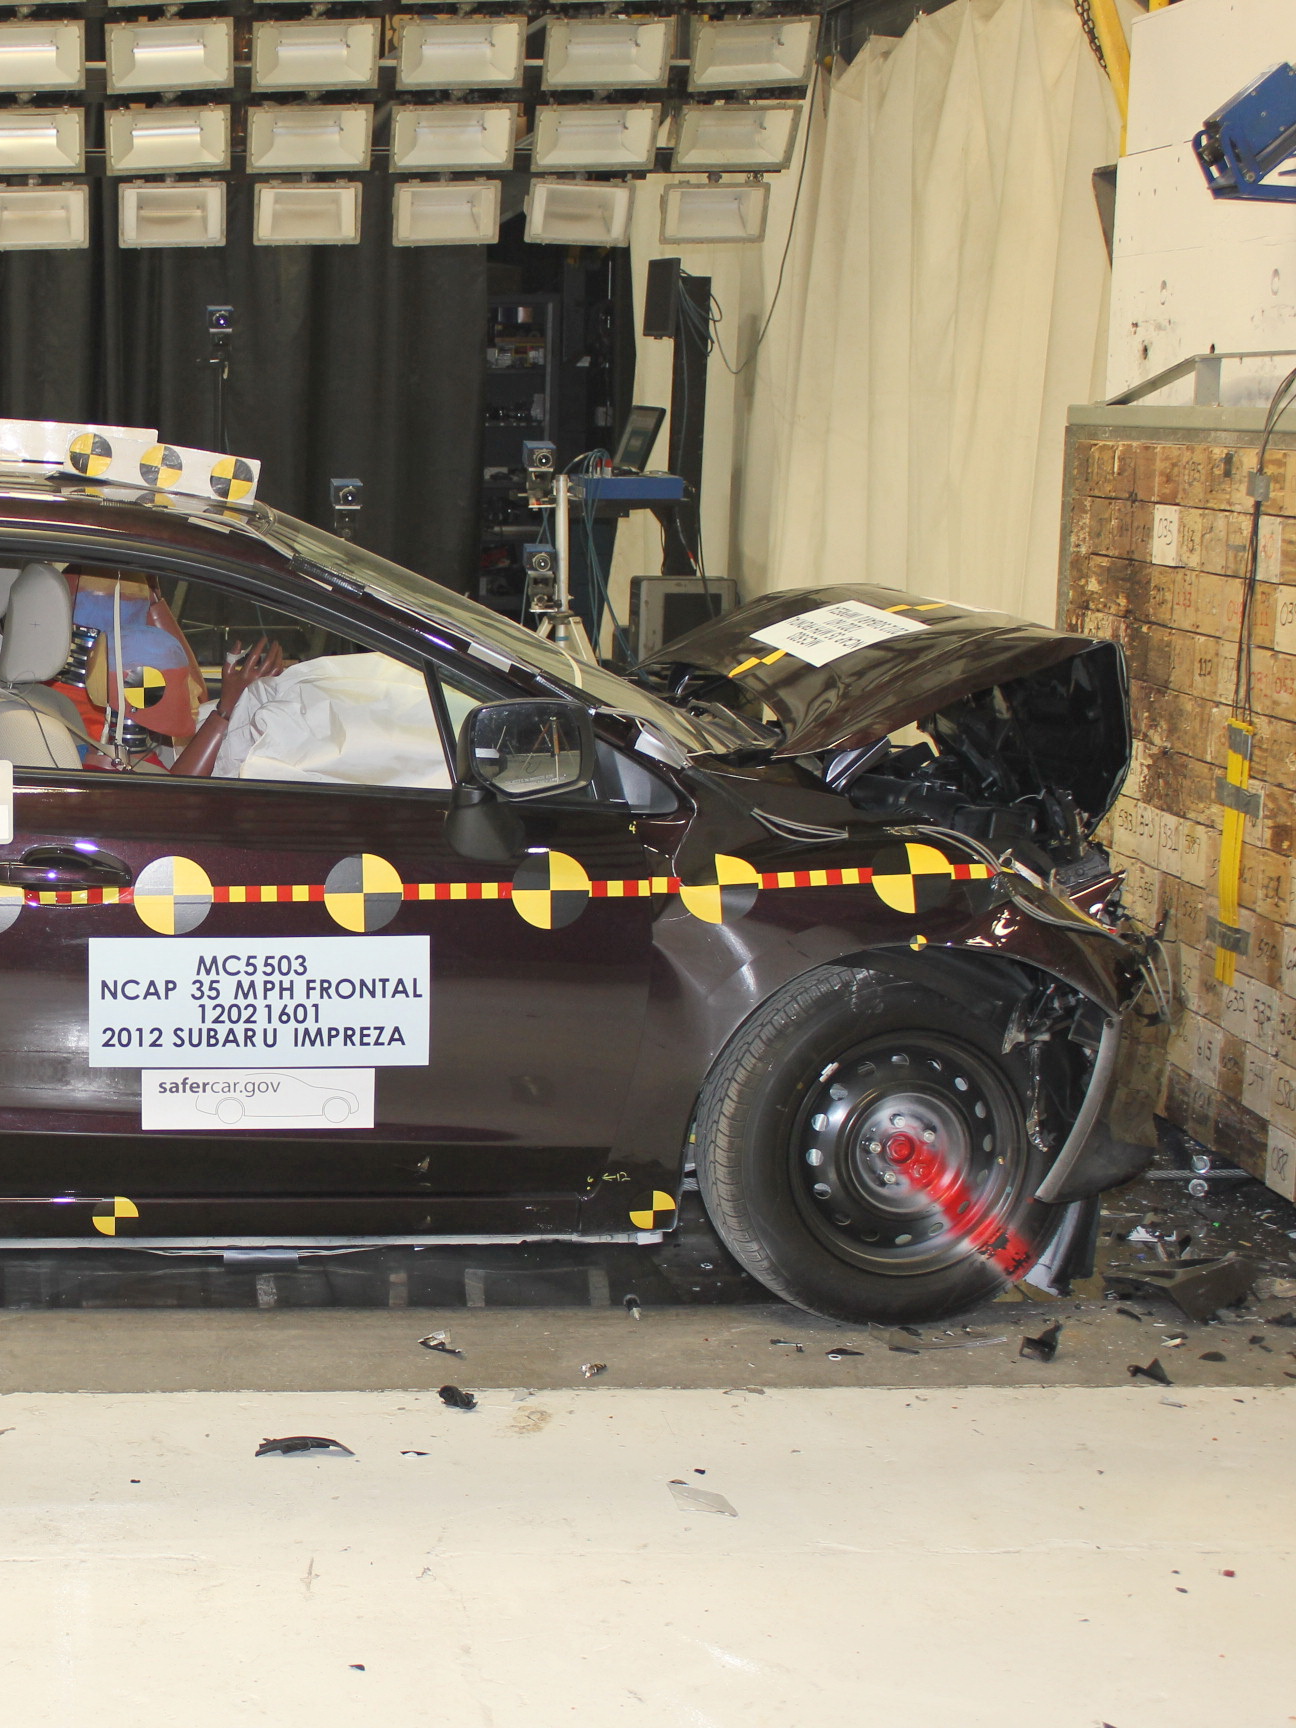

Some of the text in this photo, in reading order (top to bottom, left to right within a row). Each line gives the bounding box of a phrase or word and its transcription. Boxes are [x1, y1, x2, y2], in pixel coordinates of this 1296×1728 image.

[1157, 518, 1174, 546] 035
[195, 954, 308, 977] MC5503
[100, 977, 423, 1001] NCAP 35 MPH FRONTAL
[197, 1003, 320, 1025] 12021601
[101, 1026, 406, 1048] 2012 SUBARU IMPREZA
[158, 1077, 281, 1098] safercar.gov
